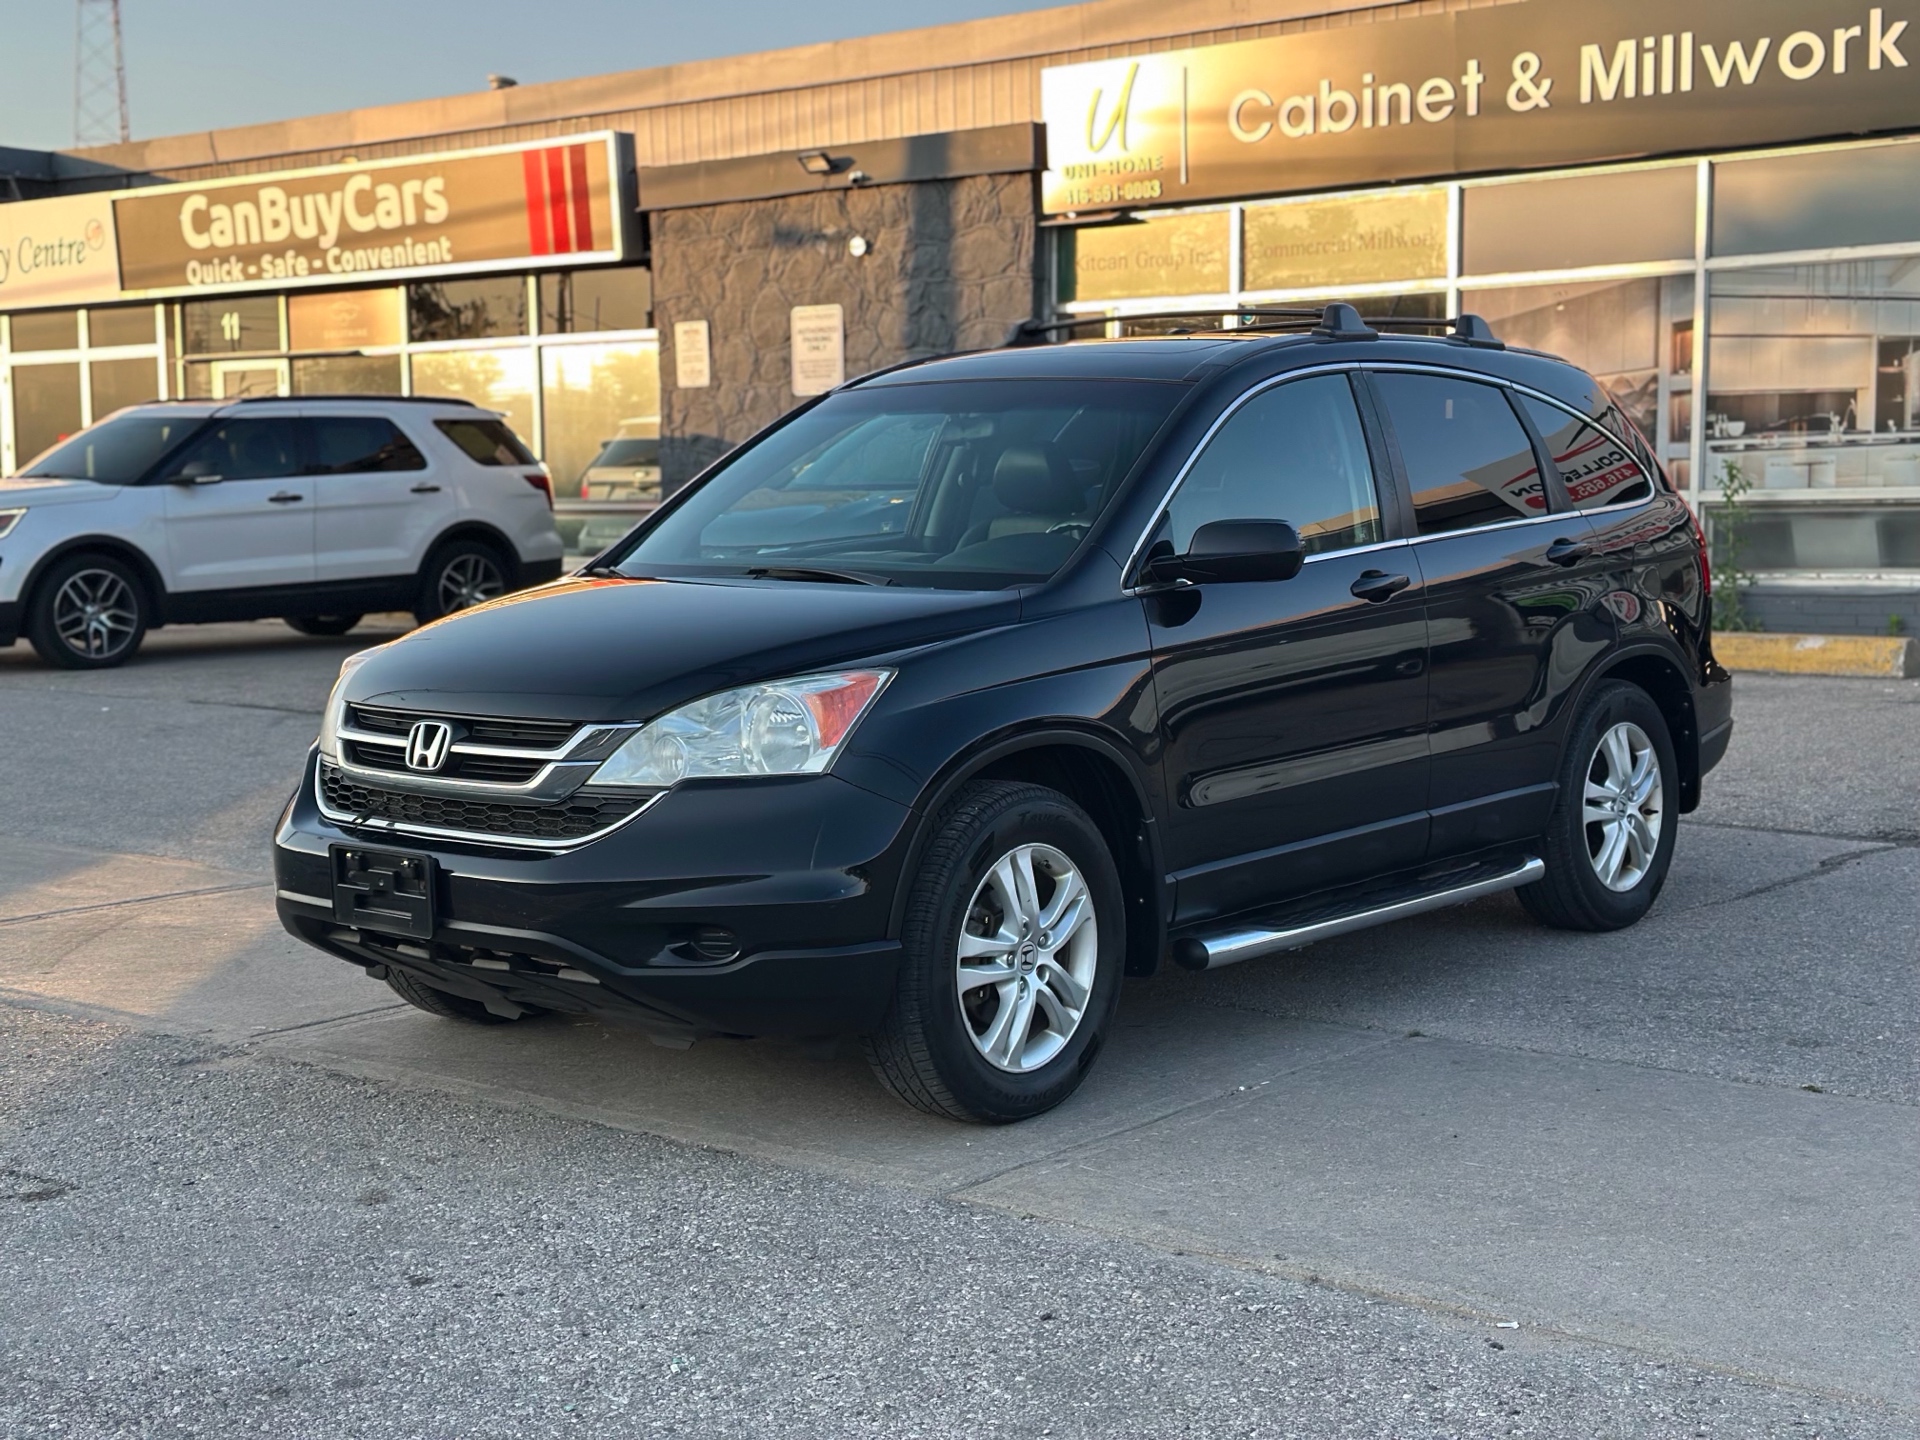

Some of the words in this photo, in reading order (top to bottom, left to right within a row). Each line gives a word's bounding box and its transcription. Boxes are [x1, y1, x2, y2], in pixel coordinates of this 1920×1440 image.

[1227, 58, 1484, 143] Cabinet
[1506, 51, 1553, 112] &
[1580, 7, 1909, 104] Millwork
[1063, 156, 1163, 179] UNI-HOME
[179, 173, 449, 249] CanBuyCars
[17, 236, 87, 273] Centre
[186, 256, 245, 286] Quick
[261, 249, 309, 280] Safe
[326, 236, 453, 273] Convenient
[1075, 254, 1129, 272] Kitcan
[1136, 250, 1186, 270] Group
[1250, 235, 1351, 259] Commercial
[221, 311, 240, 340] 11
